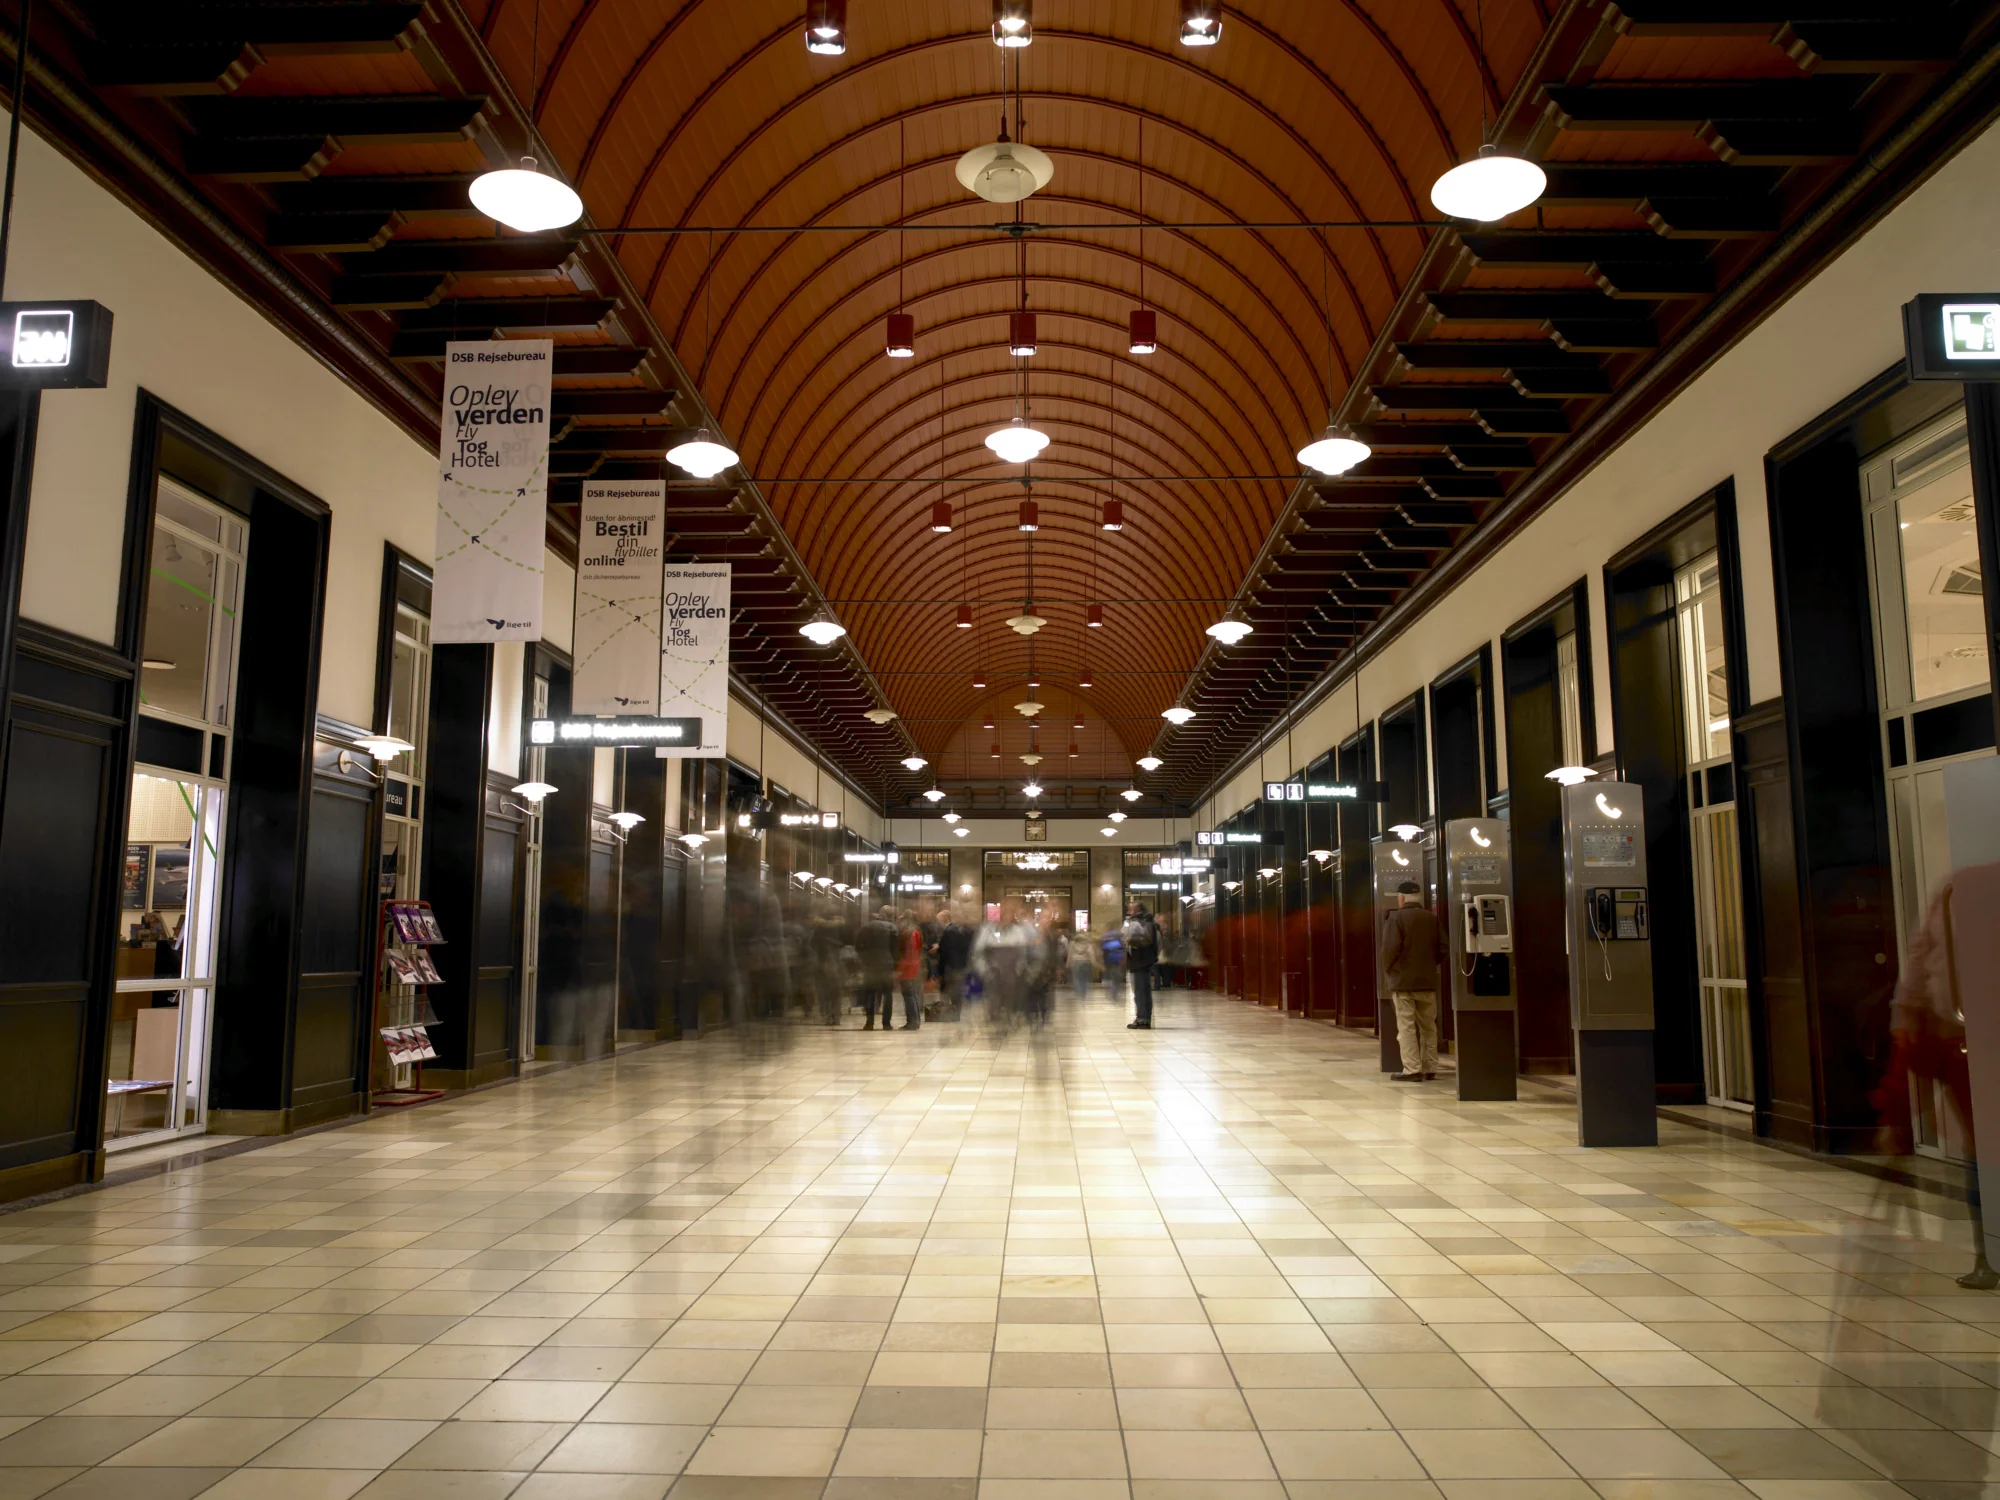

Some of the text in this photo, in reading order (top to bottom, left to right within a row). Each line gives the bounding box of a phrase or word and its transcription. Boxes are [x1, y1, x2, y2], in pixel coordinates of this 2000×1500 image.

[452, 352, 546, 363] DSB Rejsebureau
[455, 404, 544, 426] verden
[456, 424, 479, 440] Fly
[457, 440, 488, 455] Tog
[451, 452, 500, 467] Hotel
[587, 489, 660, 499] DSB Rejsebureau
[595, 521, 648, 536] Bestil
[617, 535, 638, 548] din
[614, 547, 658, 560] flybillet
[584, 555, 625, 566] online
[683, 571, 727, 579] Rejsebureau
[669, 606, 726, 619] verden
[506, 621, 522, 629] lige
[669, 618, 685, 628] Fly
[671, 628, 690, 638] Tog
[667, 635, 698, 646] Hotel
